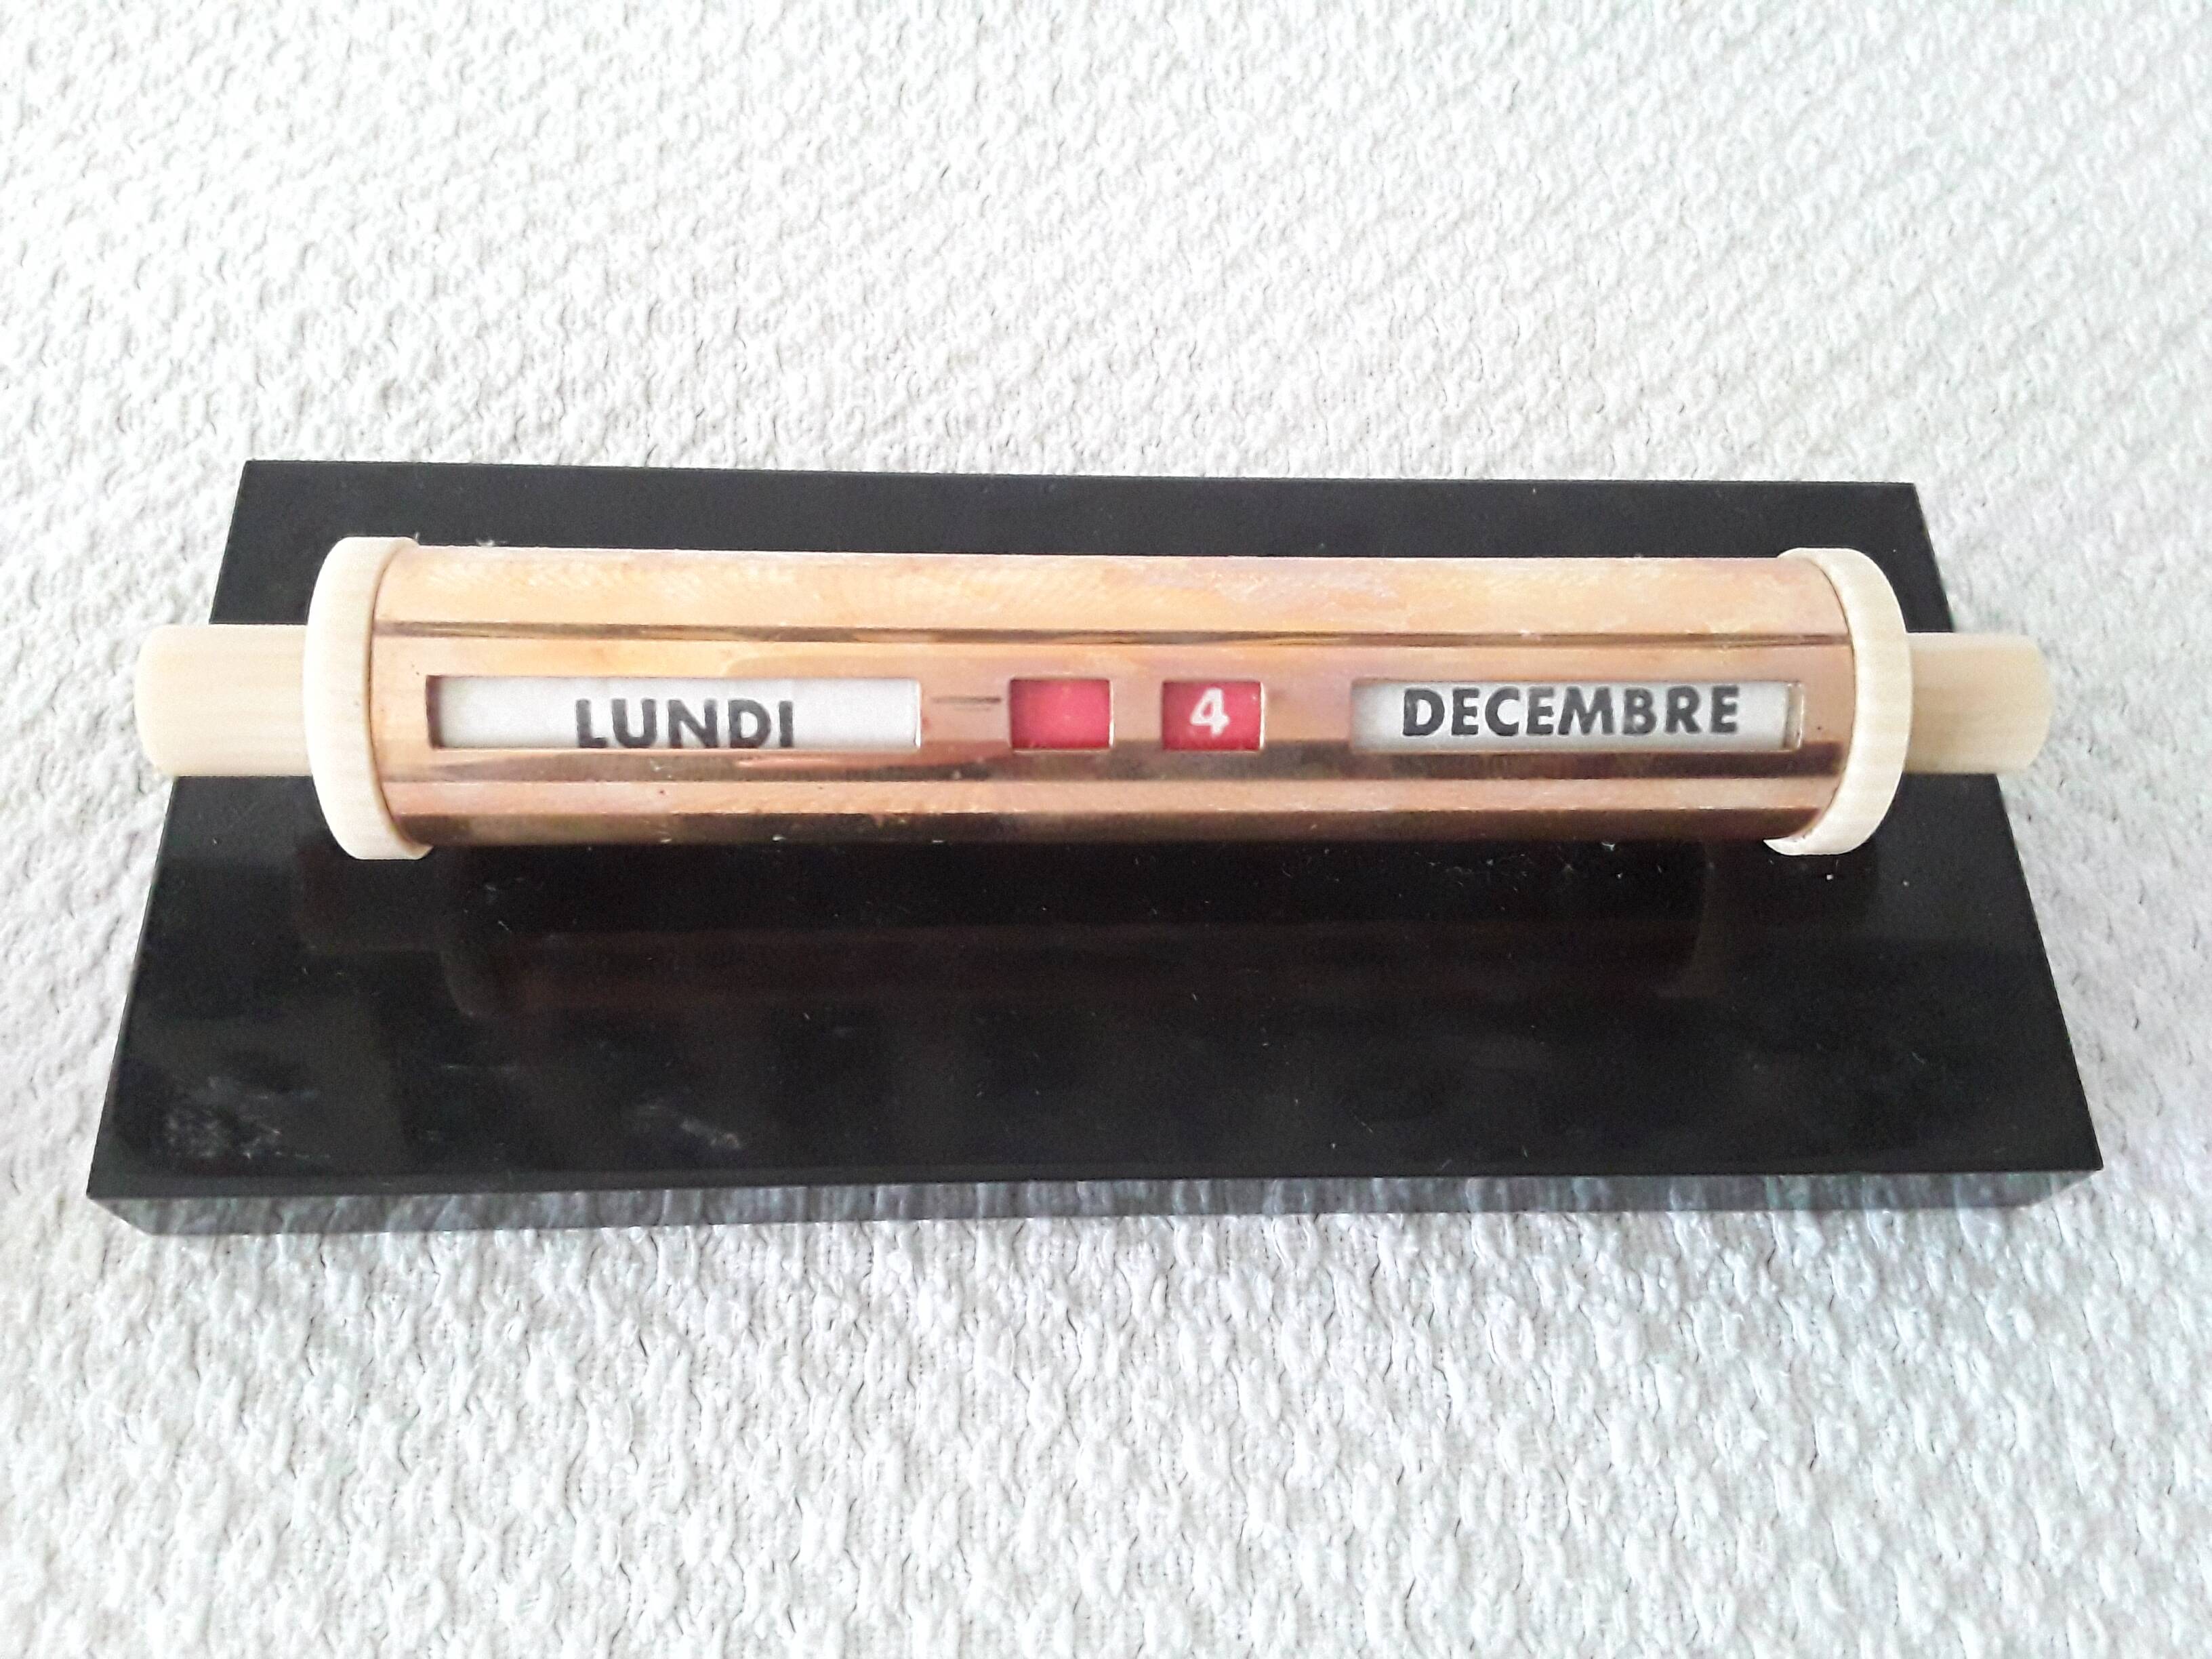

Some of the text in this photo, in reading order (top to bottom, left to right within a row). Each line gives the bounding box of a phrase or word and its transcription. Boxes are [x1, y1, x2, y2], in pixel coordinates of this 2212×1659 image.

[575, 685, 1740, 748] LUNDI 4 DECEMBRE
